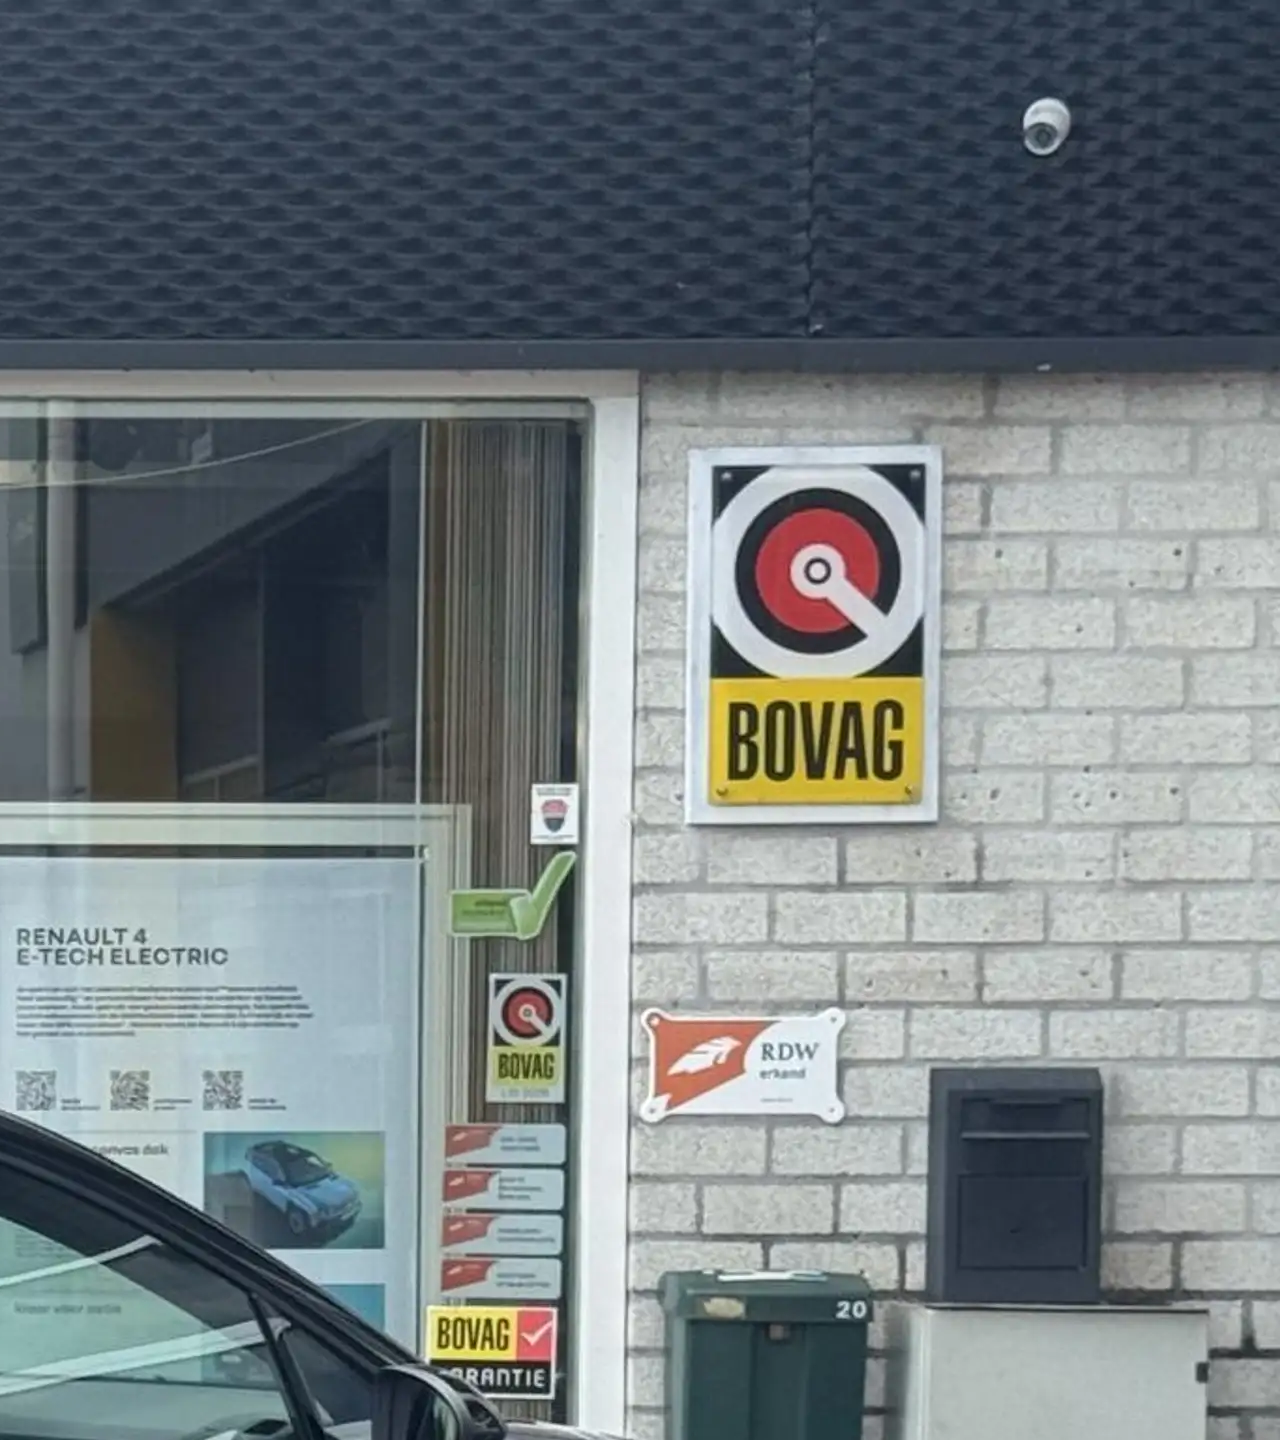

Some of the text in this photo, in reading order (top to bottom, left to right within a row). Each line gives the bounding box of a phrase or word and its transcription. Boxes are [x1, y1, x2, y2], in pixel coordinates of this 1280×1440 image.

[728, 699, 904, 781] BOVAG
[17, 928, 147, 945] RENAULT 4
[17, 948, 229, 966] E-TECH ELECTRIC
[761, 1042, 819, 1061] RDW
[498, 1053, 555, 1079] BOVAG
[836, 1300, 867, 1319] 20
[436, 1318, 510, 1351] BOVAG
[449, 1366, 546, 1388] ARANTIE
